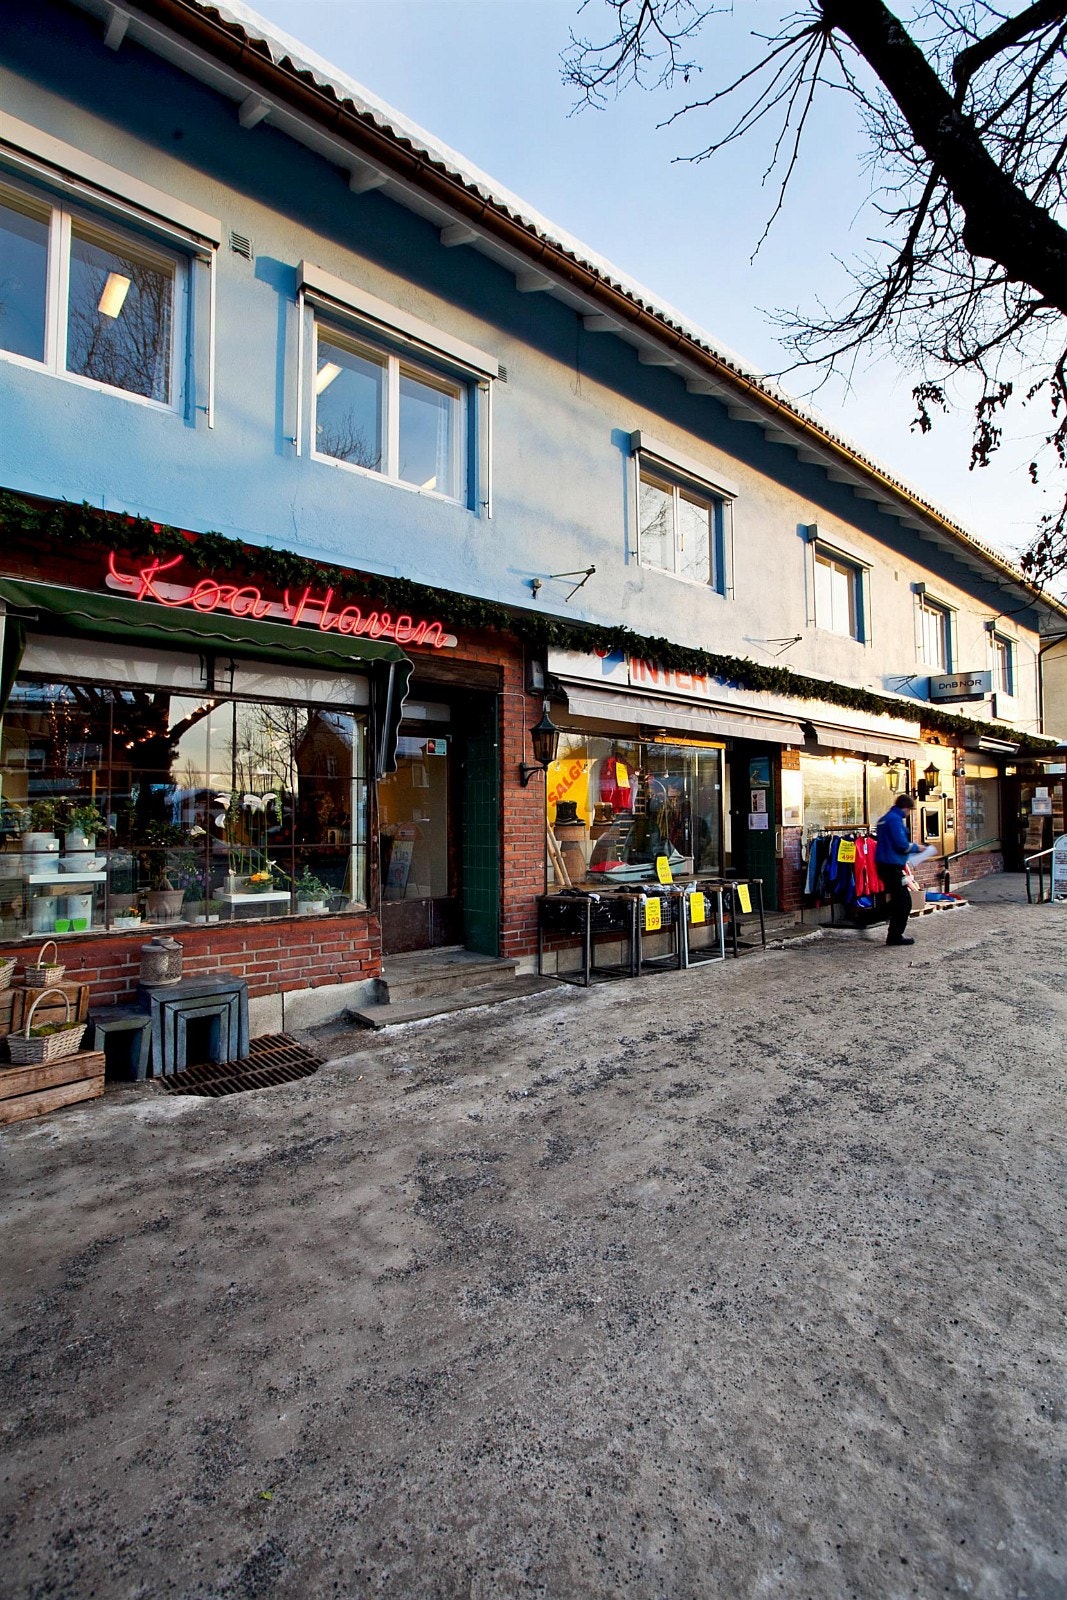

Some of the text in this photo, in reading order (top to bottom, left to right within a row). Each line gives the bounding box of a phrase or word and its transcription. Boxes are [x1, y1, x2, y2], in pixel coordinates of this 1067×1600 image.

[939, 681, 958, 690] DnB
[547, 760, 583, 803] SALG!
[648, 917, 659, 926] 199
